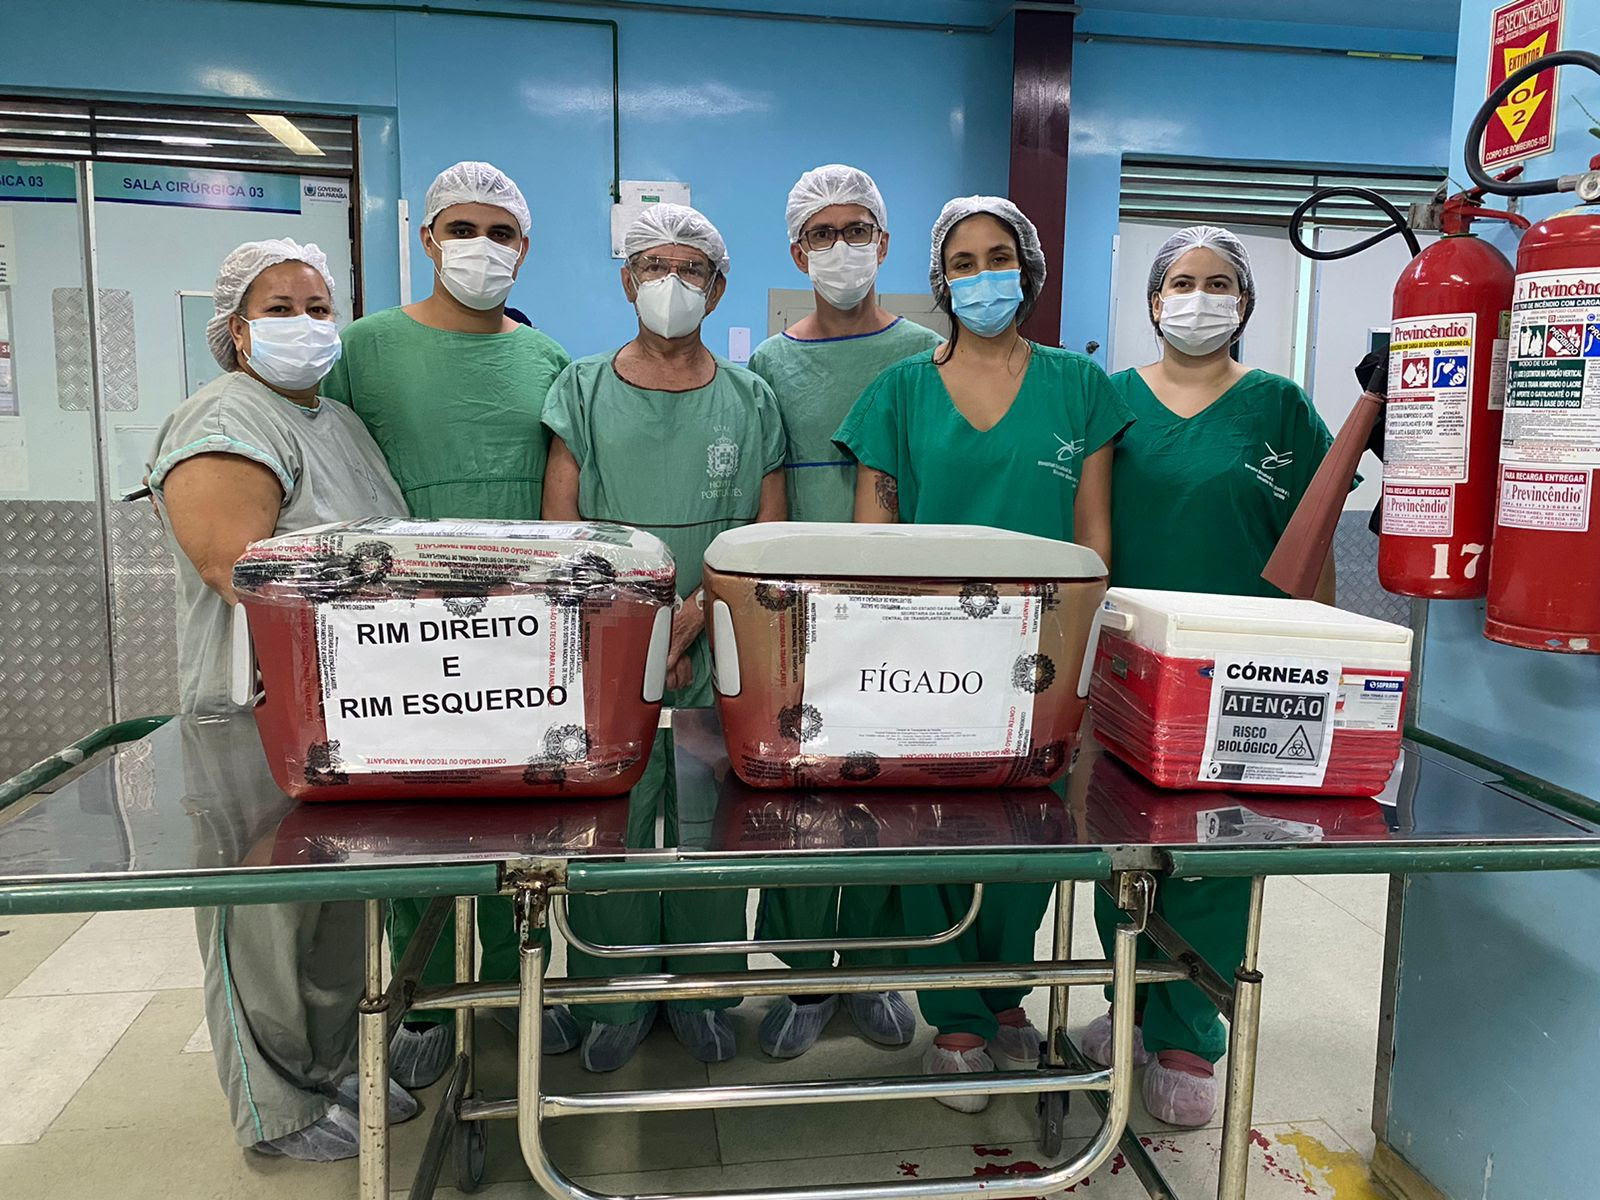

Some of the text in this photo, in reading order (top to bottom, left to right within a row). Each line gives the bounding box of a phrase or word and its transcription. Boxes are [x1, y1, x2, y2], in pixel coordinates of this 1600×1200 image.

[1509, 47, 1541, 72] EXTINTOR
[1511, 109, 1526, 126] 2
[1485, 148, 1503, 161] CORPO
[1502, 145, 1511, 156] DE
[0, 175, 44, 188] ICA 03
[123, 177, 264, 199] SALA CIRÚRGICA 03
[1535, 299, 1560, 308] INCÊNDIO
[1394, 321, 1467, 342] Previncêndio
[1549, 326, 1579, 355] PROIBIDO
[1516, 472, 1543, 482] RECARGA
[1544, 474, 1585, 483] ENTREGAR
[1416, 488, 1450, 496] ENTREGAR
[1511, 484, 1581, 504] Previncêndio
[460, 543, 477, 551] PARA
[477, 544, 500, 553] TECIDO
[1430, 543, 1485, 580] 17
[357, 614, 539, 645] RIM DIREITO
[549, 621, 557, 630] OU
[549, 631, 557, 651] TECIDO
[442, 655, 461, 678] E
[1226, 661, 1329, 685] CÓRNEAS
[858, 661, 984, 695] FÍGADO
[339, 685, 568, 719] RIM ESQUERDO
[1224, 695, 1323, 719] ATENÇÃO
[1232, 725, 1267, 739] RISCO
[1216, 738, 1278, 755] BIOLÓGICO
[409, 757, 427, 765] PARA
[426, 757, 448, 765] TECIDO
